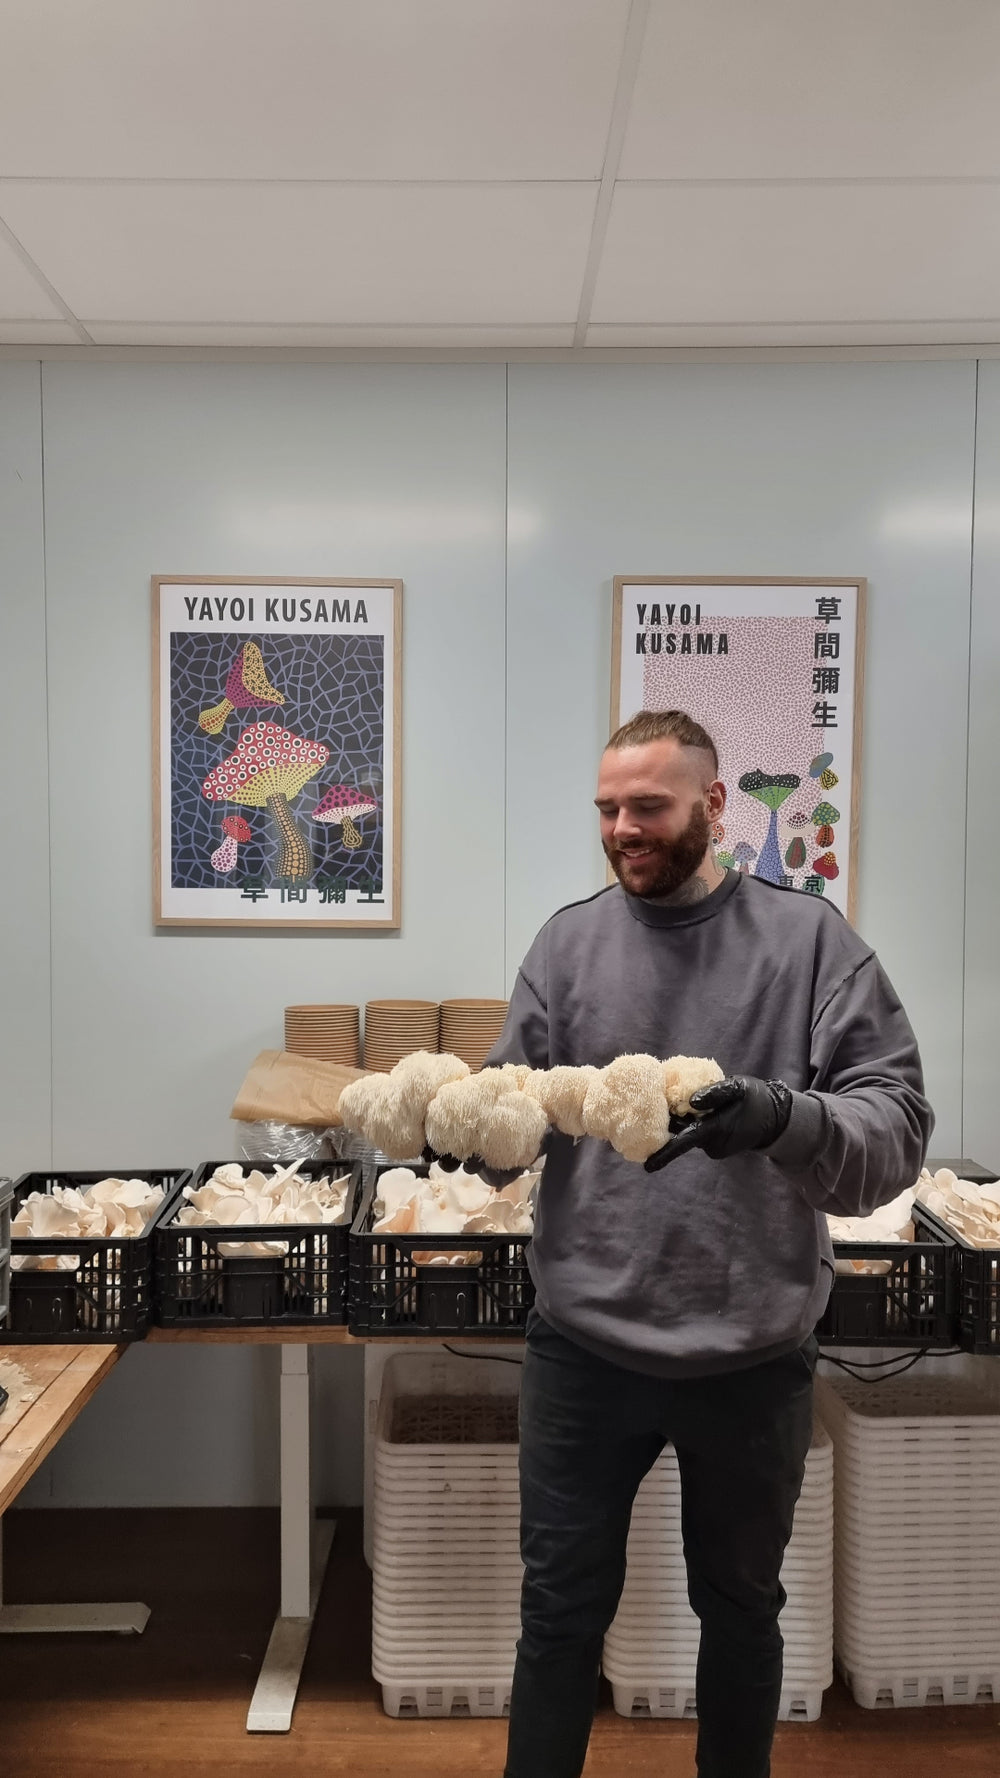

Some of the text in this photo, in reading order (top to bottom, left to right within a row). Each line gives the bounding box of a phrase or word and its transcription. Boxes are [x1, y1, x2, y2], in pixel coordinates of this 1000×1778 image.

[184, 597, 369, 623] YAYOI KUSAMA
[636, 604, 701, 625] YAYOI
[636, 633, 729, 655] KUSAMA
[811, 597, 842, 728] 草間彌生
